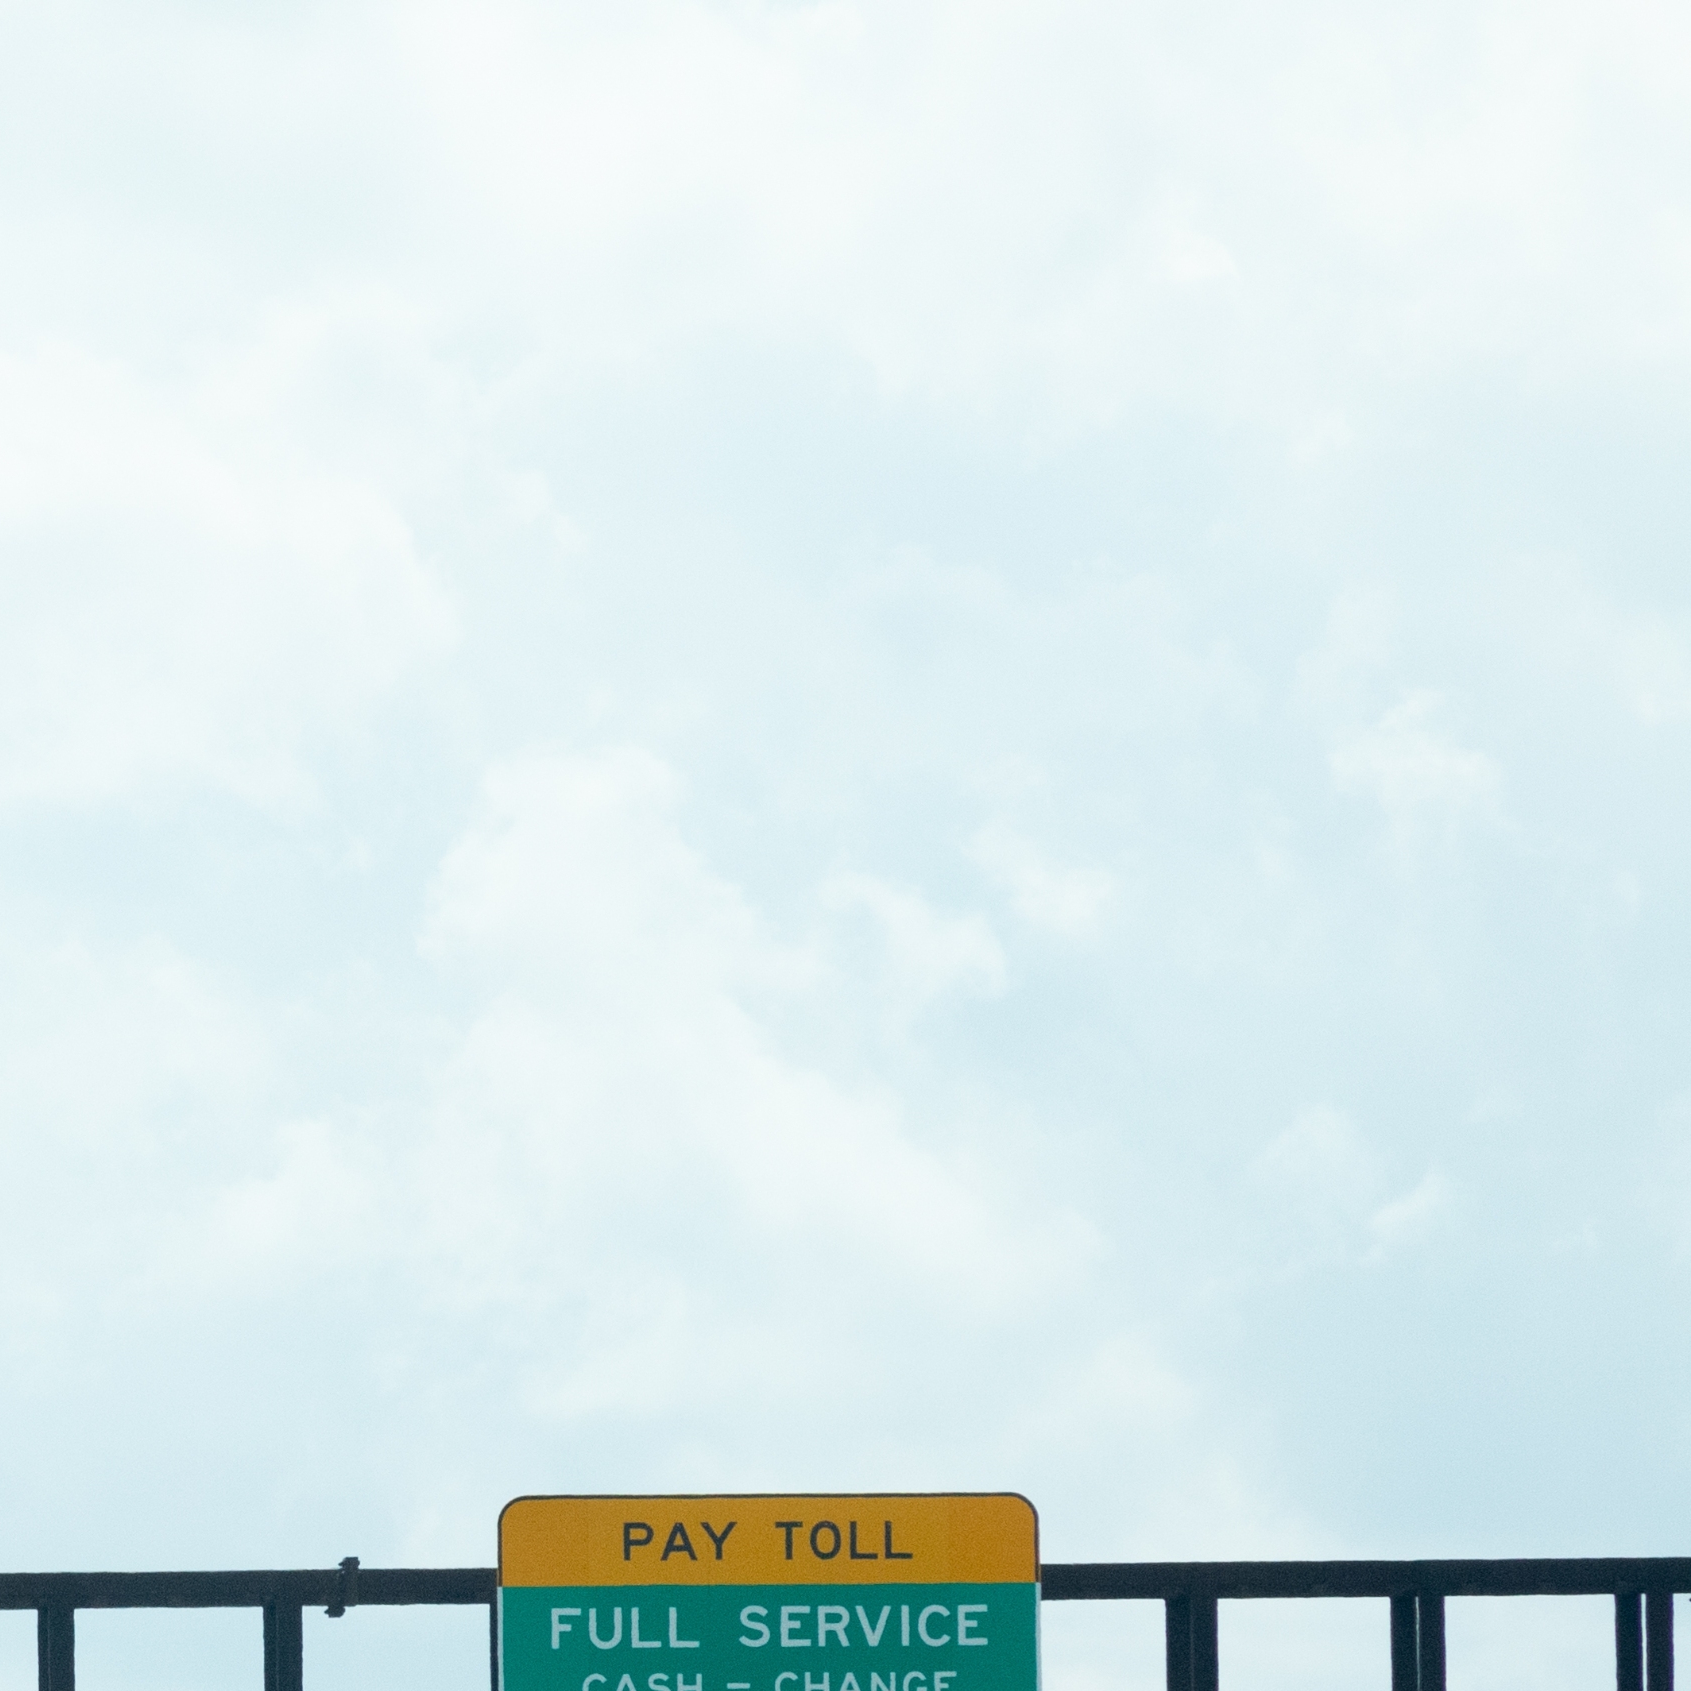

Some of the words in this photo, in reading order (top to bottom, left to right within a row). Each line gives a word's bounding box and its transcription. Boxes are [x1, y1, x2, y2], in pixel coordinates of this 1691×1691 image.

[622, 1520, 738, 1562] PAY
[775, 1520, 914, 1561] TOLL
[550, 1606, 700, 1650] FULL
[738, 1604, 989, 1648] SERVICE
